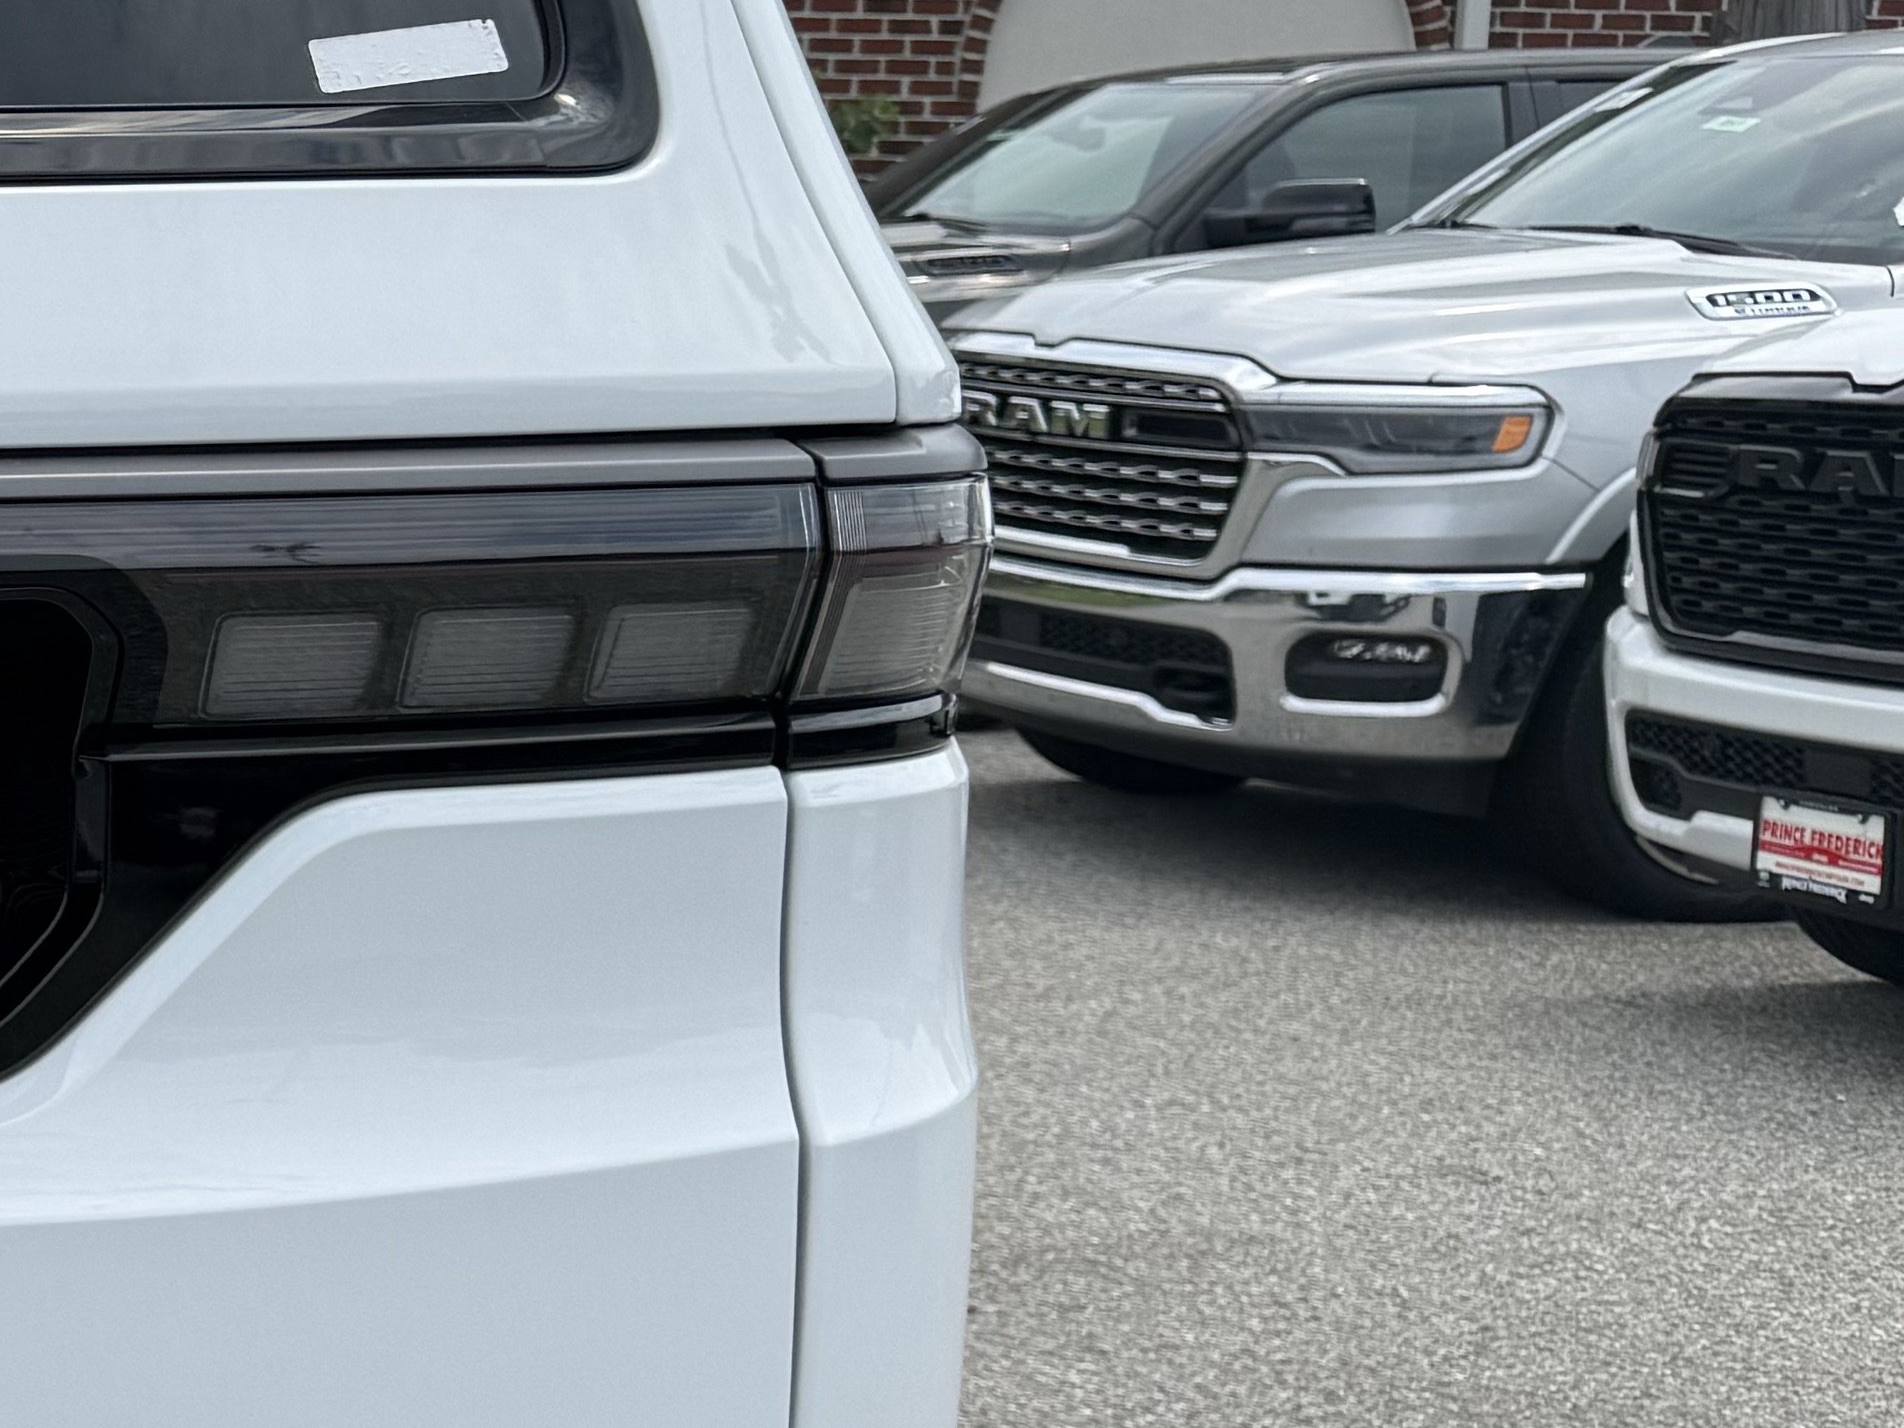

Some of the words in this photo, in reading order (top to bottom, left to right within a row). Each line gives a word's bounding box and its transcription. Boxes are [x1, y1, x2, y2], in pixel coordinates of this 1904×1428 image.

[1712, 289, 1811, 307] 1500
[960, 389, 1110, 439] RAM
[1735, 444, 1904, 498] RA
[1762, 820, 1806, 846] PRINCE
